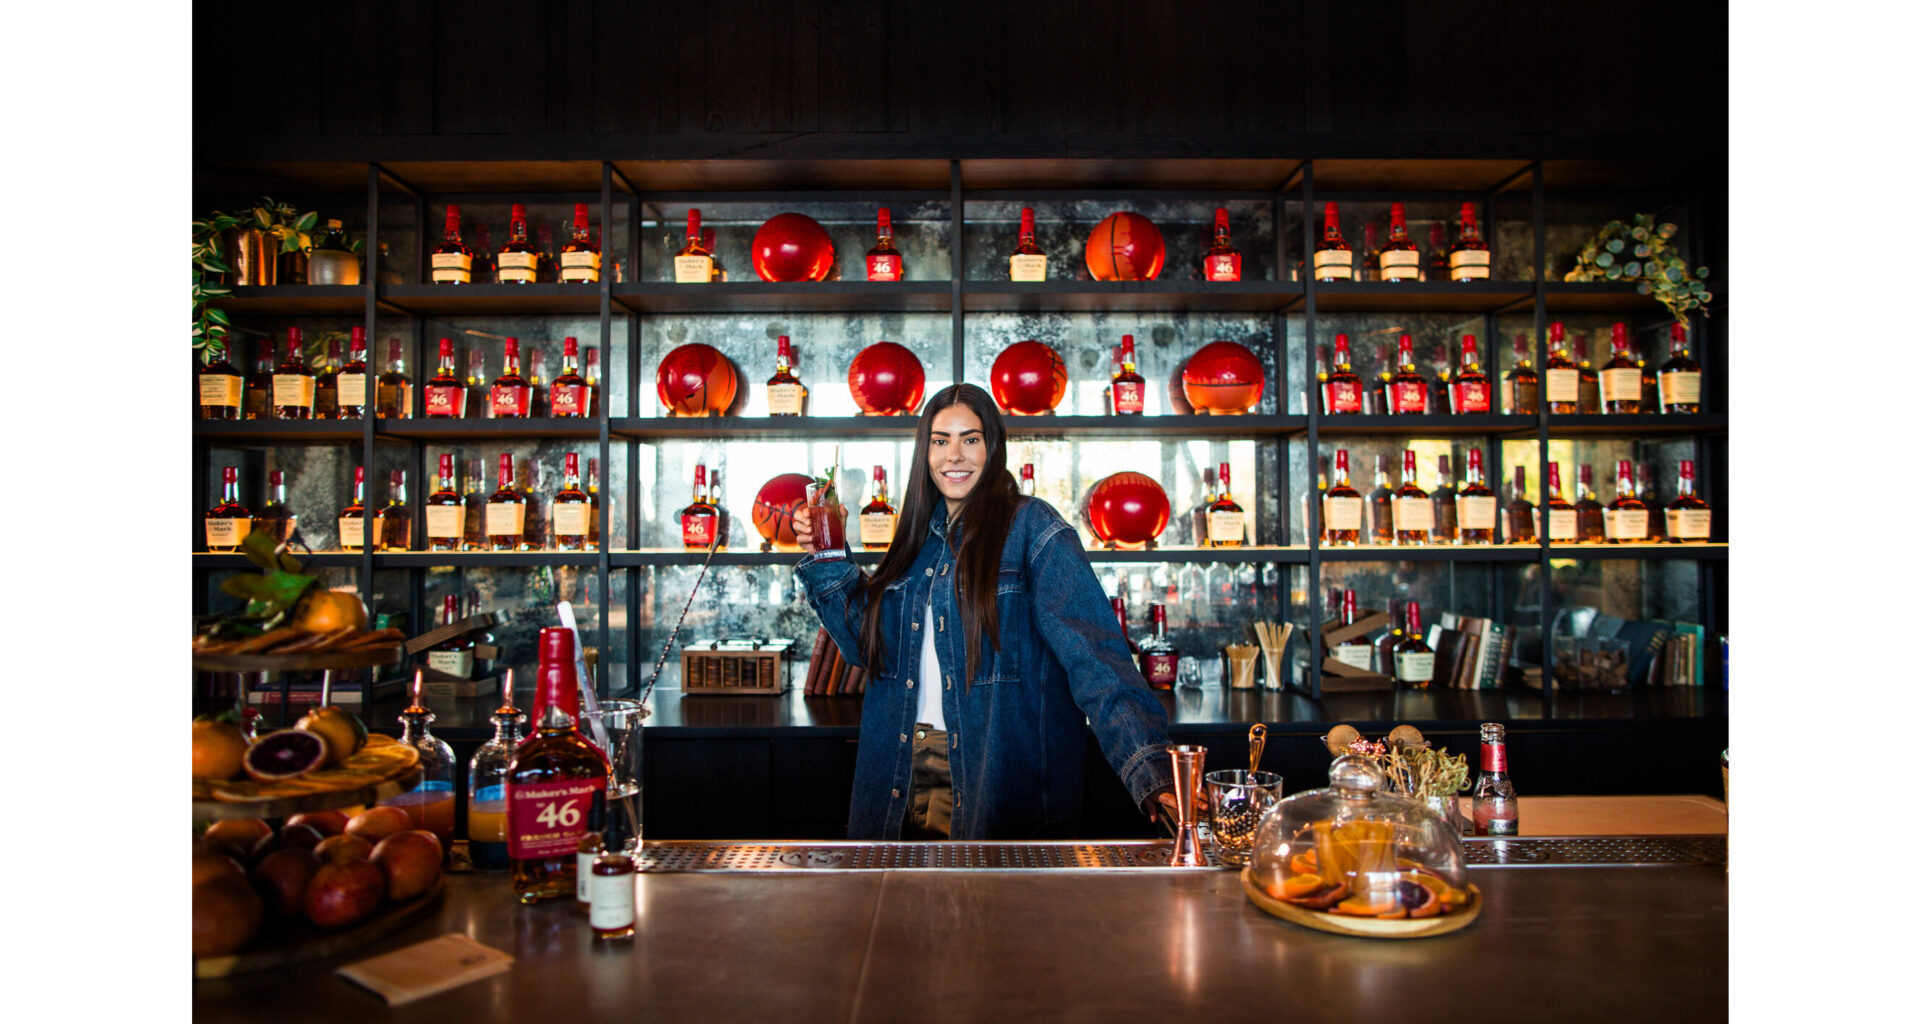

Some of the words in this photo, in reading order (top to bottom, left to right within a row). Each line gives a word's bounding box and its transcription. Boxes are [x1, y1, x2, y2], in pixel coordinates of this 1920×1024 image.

[873, 262, 891, 274] 46
[1215, 262, 1233, 274] 46
[430, 393, 448, 405] 46
[496, 393, 514, 405] 46
[556, 393, 573, 405] 46
[1121, 390, 1138, 402] 46
[687, 522, 705, 534] 46
[1154, 662, 1171, 674] 46
[525, 789, 568, 799] Maker's
[536, 799, 581, 829] 46
